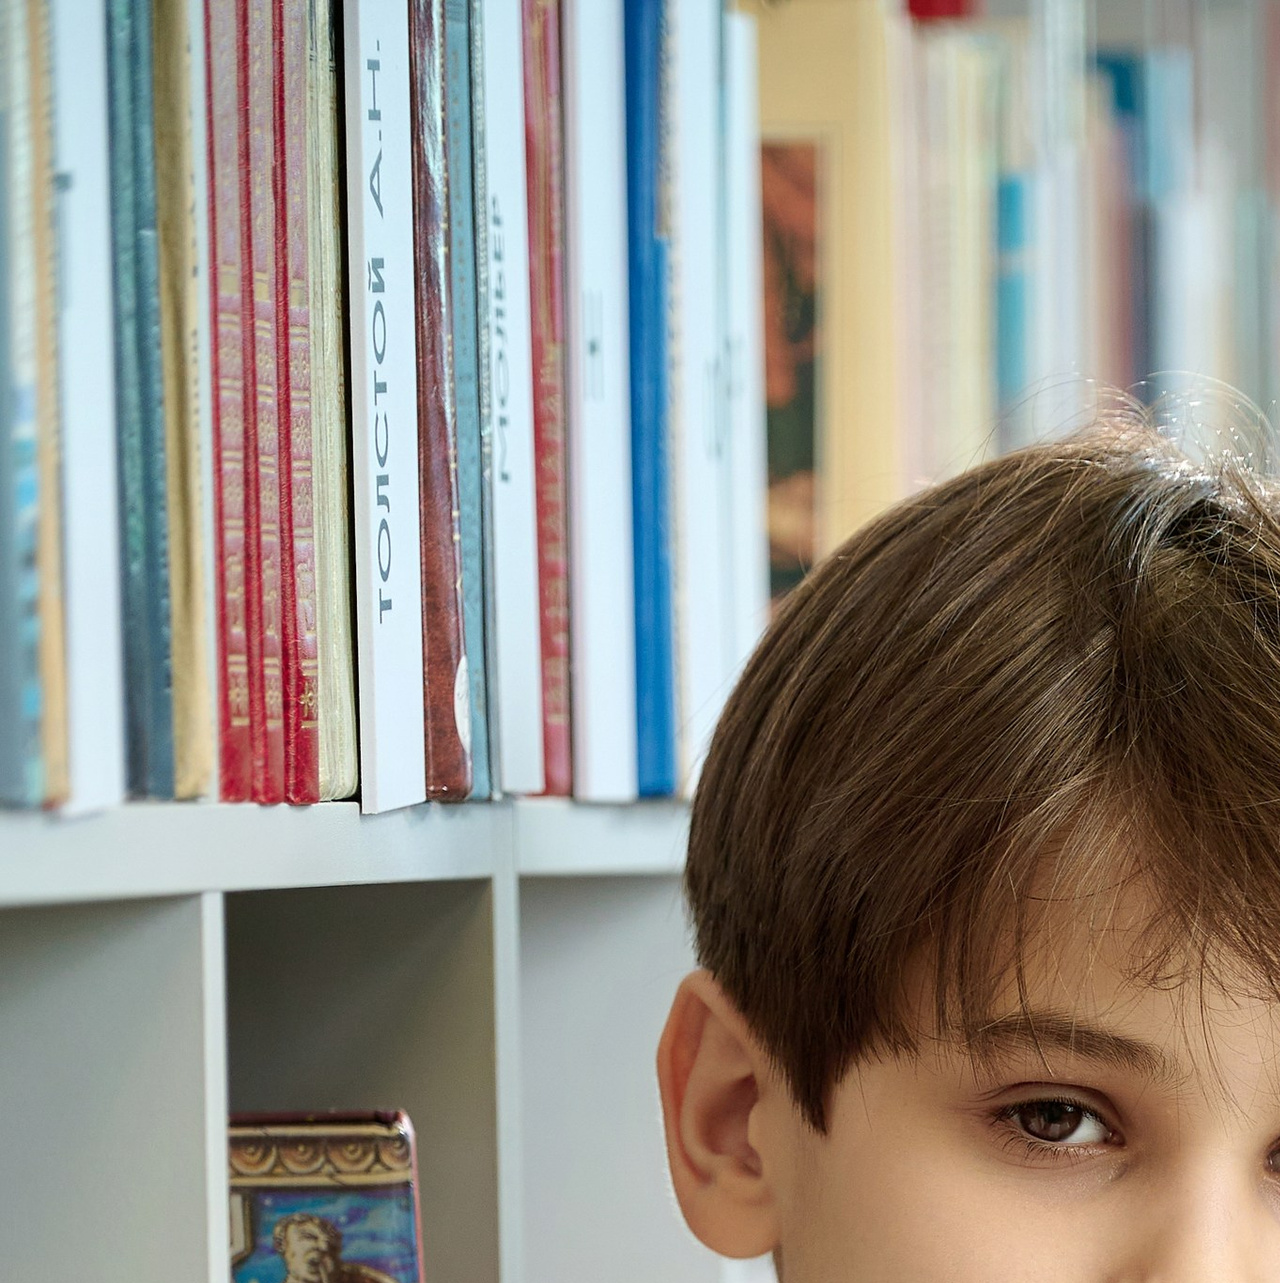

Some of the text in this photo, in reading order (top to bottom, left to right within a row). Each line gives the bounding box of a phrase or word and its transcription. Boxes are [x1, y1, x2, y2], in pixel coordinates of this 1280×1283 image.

[367, 39, 394, 624] ТОЛСТОЙ А.Н.
[490, 193, 511, 485] МОЛЬЕР
